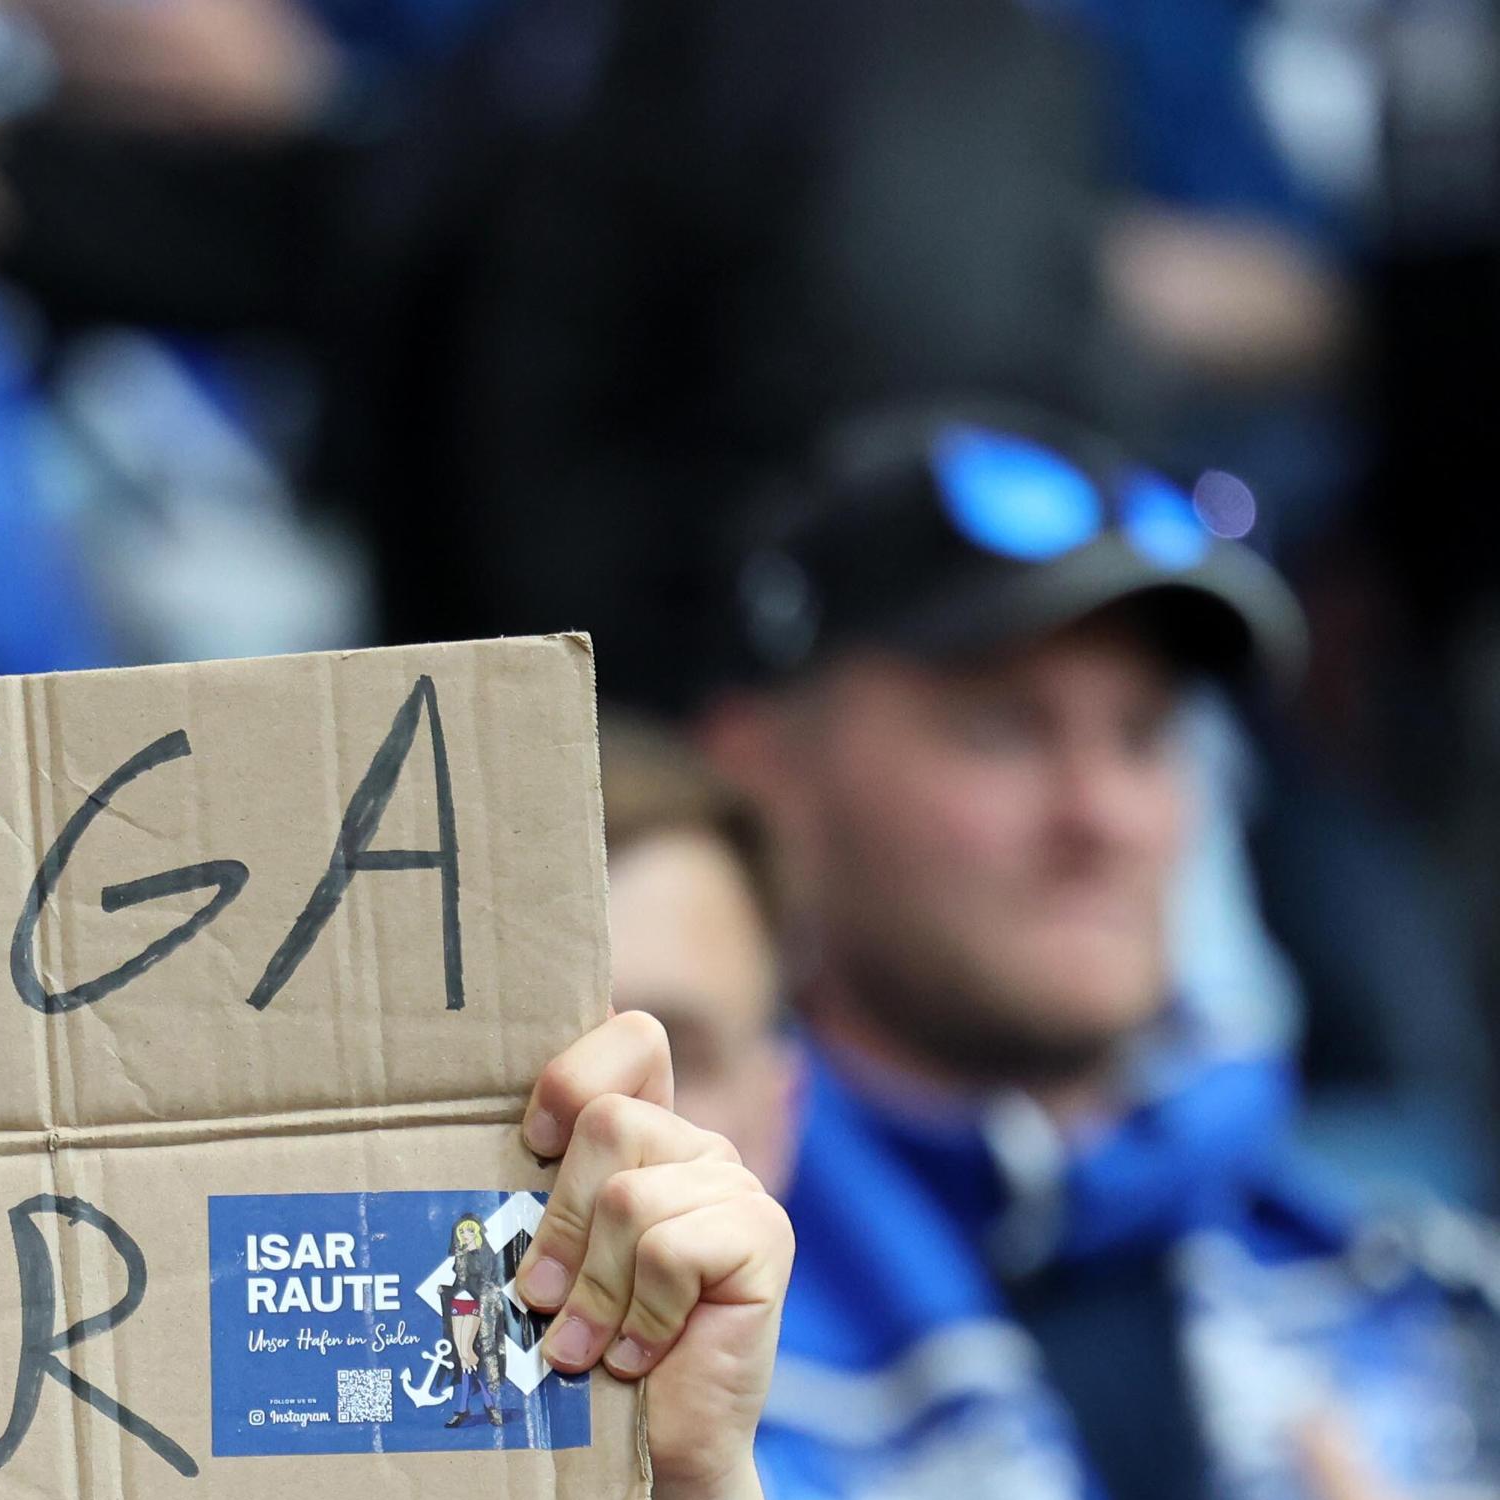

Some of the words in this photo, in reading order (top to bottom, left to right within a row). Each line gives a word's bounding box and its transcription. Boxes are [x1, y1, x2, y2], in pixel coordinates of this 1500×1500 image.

[246, 1232, 356, 1272] ISAR
[247, 1274, 401, 1315] RAUTE
[248, 1328, 290, 1353] Unser
[296, 1326, 344, 1356] Hafen
[346, 1333, 367, 1346] im
[371, 1320, 422, 1353] Süden
[269, 1409, 332, 1428] Instagram
